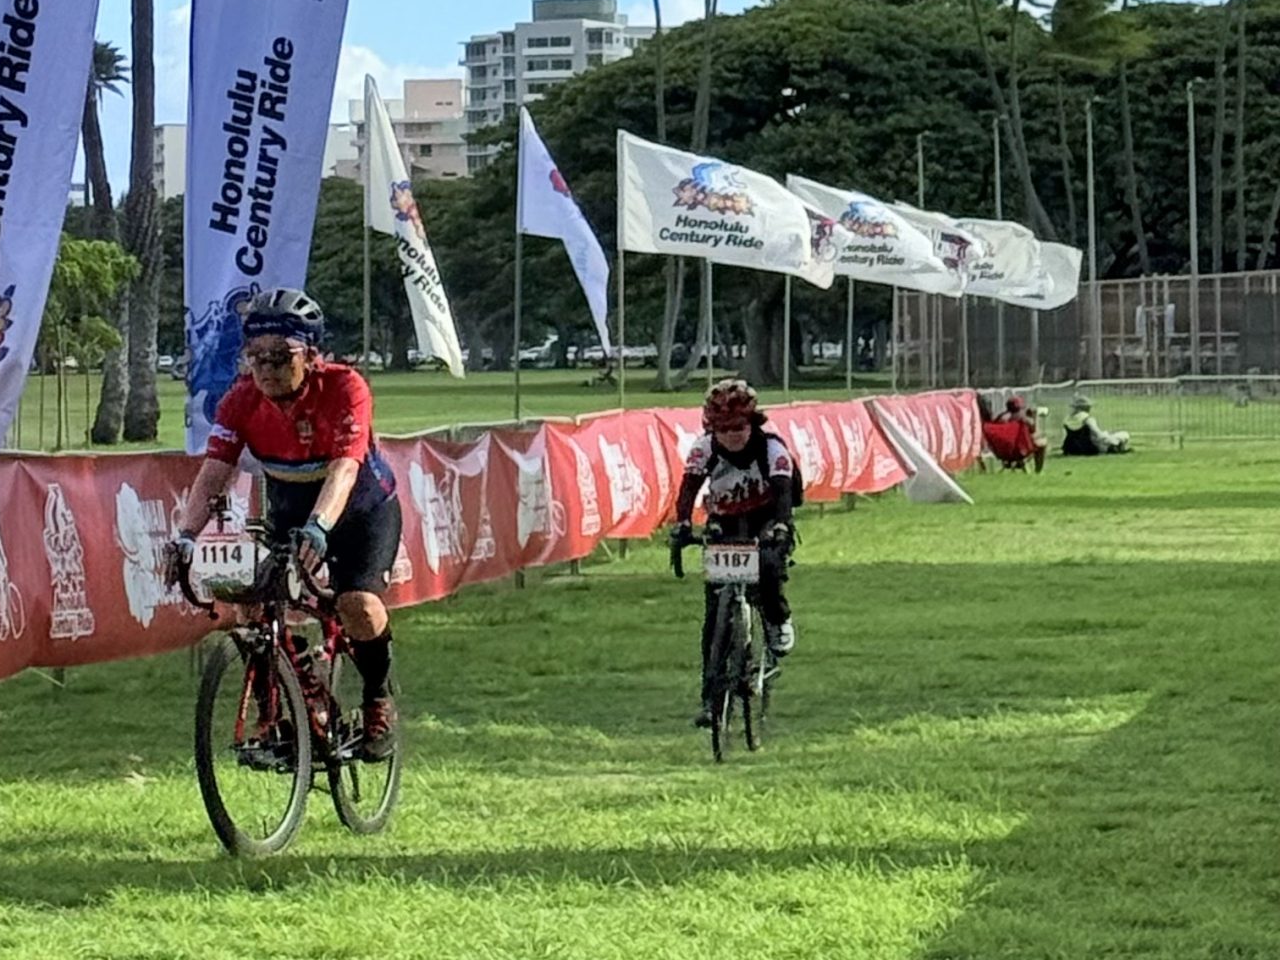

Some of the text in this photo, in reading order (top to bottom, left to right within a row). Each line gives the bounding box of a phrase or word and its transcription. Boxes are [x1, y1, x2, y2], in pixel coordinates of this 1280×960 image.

[257, 37, 293, 121] Ride
[209, 69, 258, 235] Honolulu
[235, 125, 287, 276] Century
[675, 214, 750, 234] Honolulu
[396, 233, 442, 286] nolulu
[659, 228, 764, 250] Century Ride
[413, 273, 446, 314] Ride
[201, 545, 242, 563] 1114
